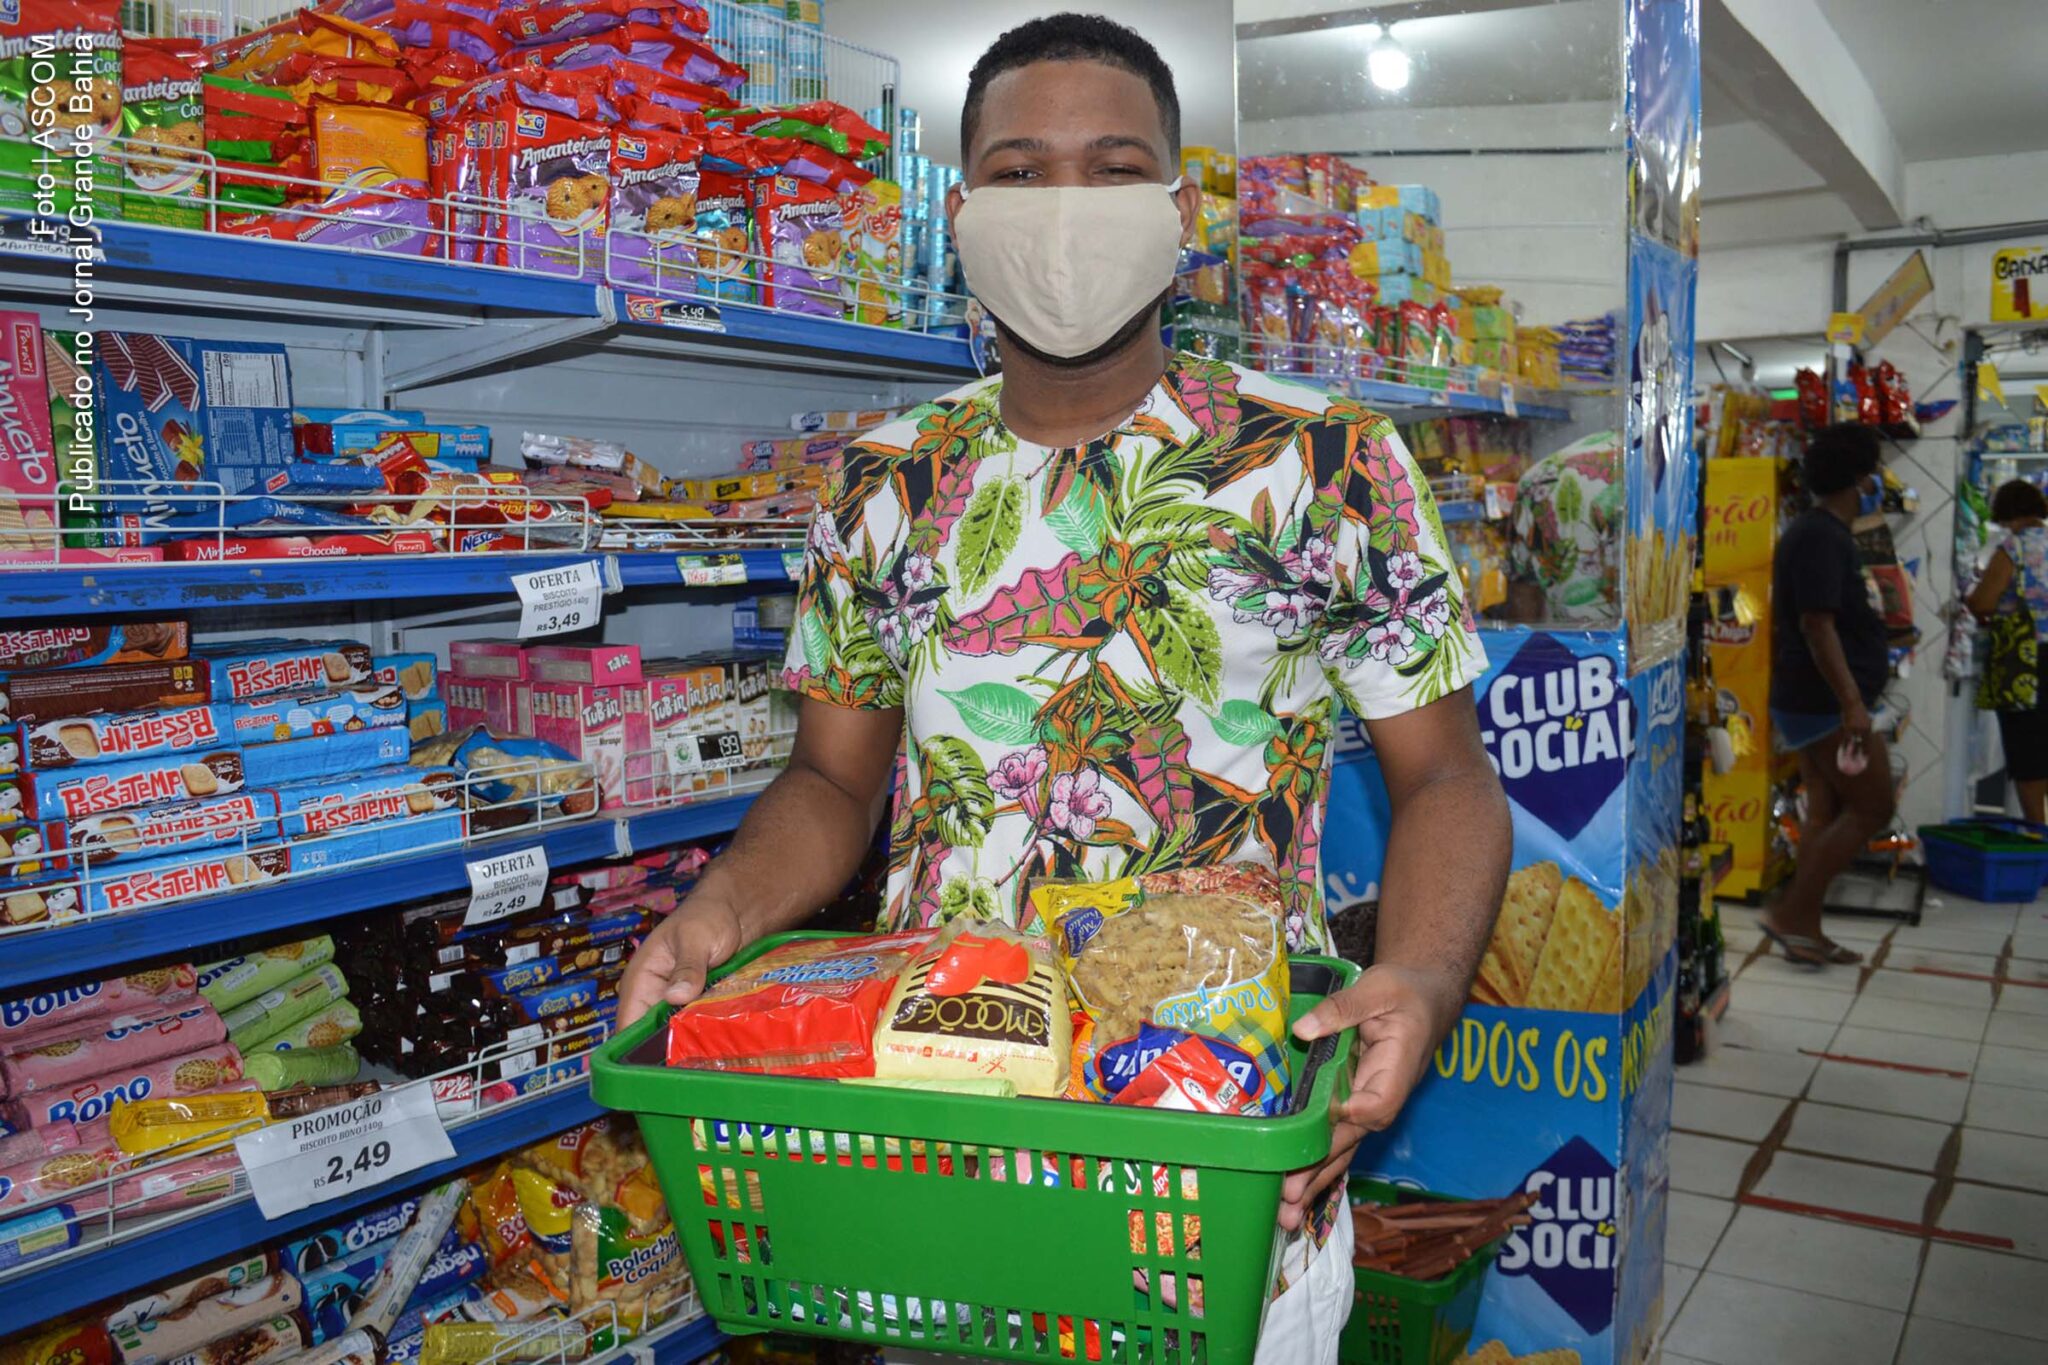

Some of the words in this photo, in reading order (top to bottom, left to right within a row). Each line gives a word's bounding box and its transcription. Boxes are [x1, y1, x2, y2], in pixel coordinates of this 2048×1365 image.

[301, 545, 348, 557] Chocolate
[529, 569, 581, 590] OFERTA
[542, 588, 578, 601] BISCOITO
[533, 599, 573, 612] PRESTIGIO
[548, 611, 581, 631] 3,49
[1489, 655, 1616, 729] CLUB
[482, 853, 535, 879] OFERTA
[493, 874, 529, 889] BISCOITO
[474, 883, 526, 903] PASSATEMPO
[492, 894, 526, 915] 2,49
[1, 981, 103, 1028] Bono
[1159, 978, 1278, 1027] Parafuso
[1553, 1029, 1609, 1103] OS
[49, 1075, 153, 1126] Bono
[291, 1098, 383, 1140] PROMOÇÃO
[299, 1134, 338, 1153] BISCOITO
[338, 1126, 363, 1141] BONO
[363, 1120, 384, 1135] 140g
[313, 1175, 326, 1190] R$
[326, 1140, 392, 1185] 2,49
[1525, 1170, 1621, 1221] CLU
[1500, 1222, 1618, 1271] SOCI
